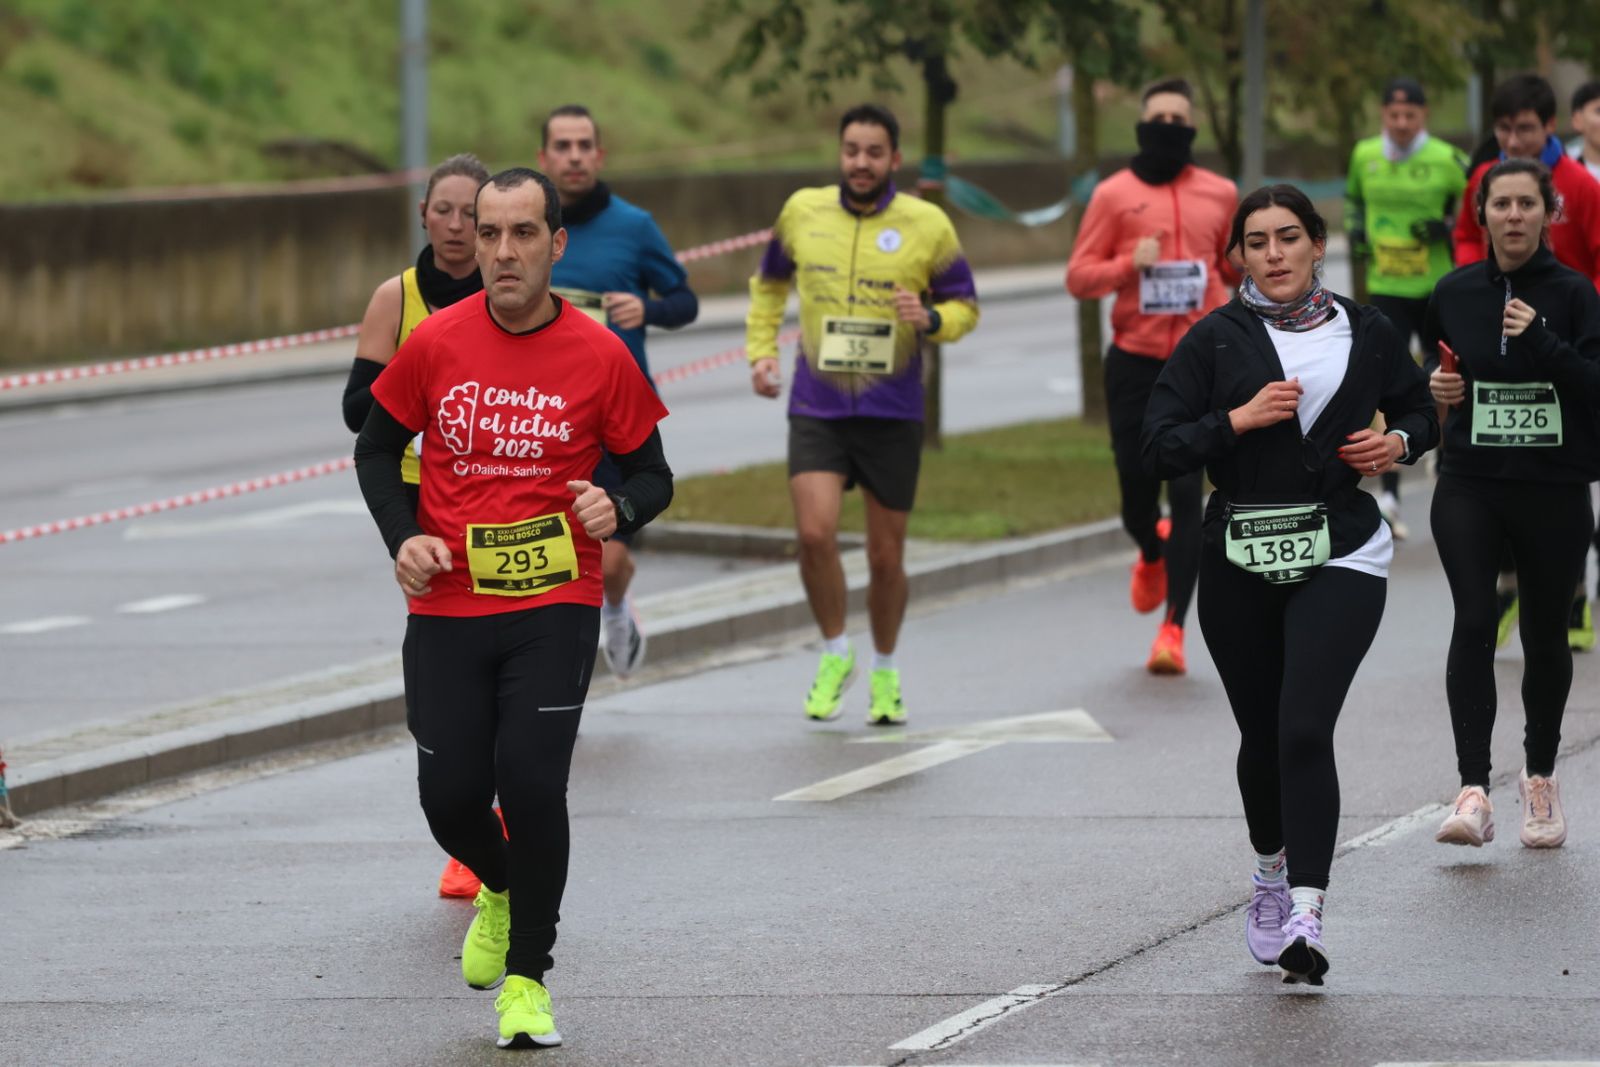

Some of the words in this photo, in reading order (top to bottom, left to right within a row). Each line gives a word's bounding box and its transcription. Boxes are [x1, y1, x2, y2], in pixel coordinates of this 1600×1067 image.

[484, 386, 567, 411] contra
[480, 412, 505, 434] el
[509, 413, 574, 442] ictus
[1487, 408, 1548, 429] 1326
[492, 438, 544, 458] 2025
[471, 463, 552, 477] Daiichi-Sankyo
[1254, 524, 1271, 532] DON
[1272, 521, 1298, 531] BOSCO
[1266, 517, 1289, 525] CARRERA
[1289, 514, 1312, 522] POPULAR
[497, 533, 515, 542] DON
[516, 528, 541, 539] BOSCO
[495, 545, 549, 574] 293
[1243, 536, 1314, 567] 1382
